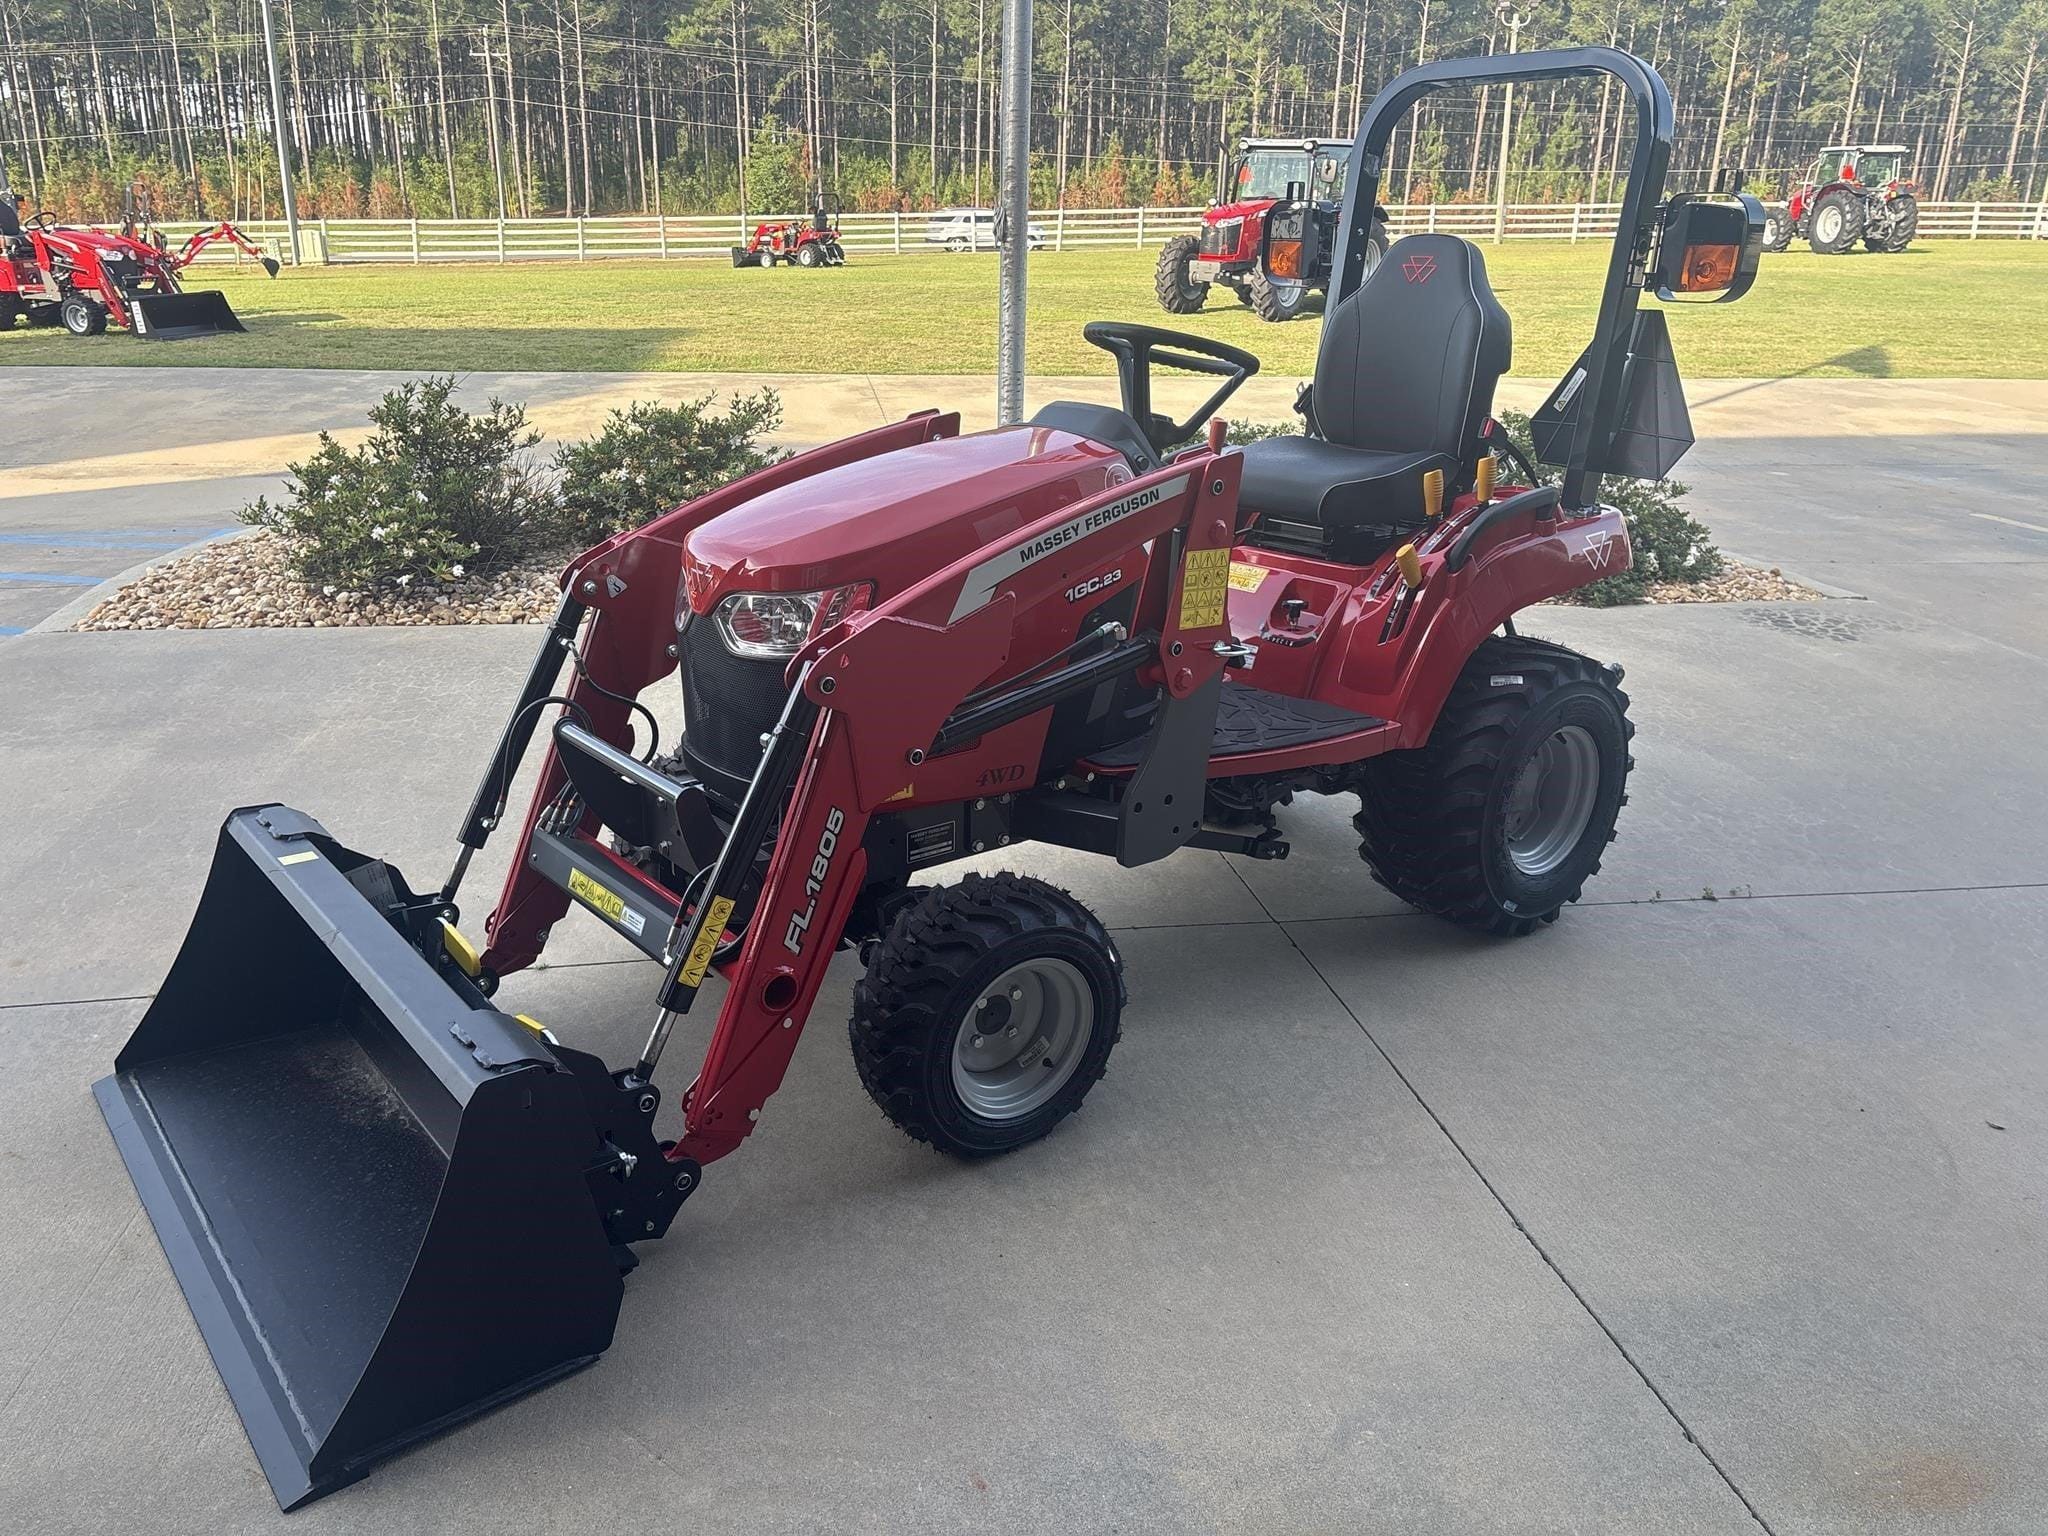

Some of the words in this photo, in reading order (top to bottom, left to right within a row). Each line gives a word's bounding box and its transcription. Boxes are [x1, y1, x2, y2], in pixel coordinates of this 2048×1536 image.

[1019, 523, 1080, 563] MASSEY
[1084, 488, 1160, 531] FERGUSON
[1064, 568, 1122, 602] 1GC.23
[975, 763, 1025, 788] 4WD
